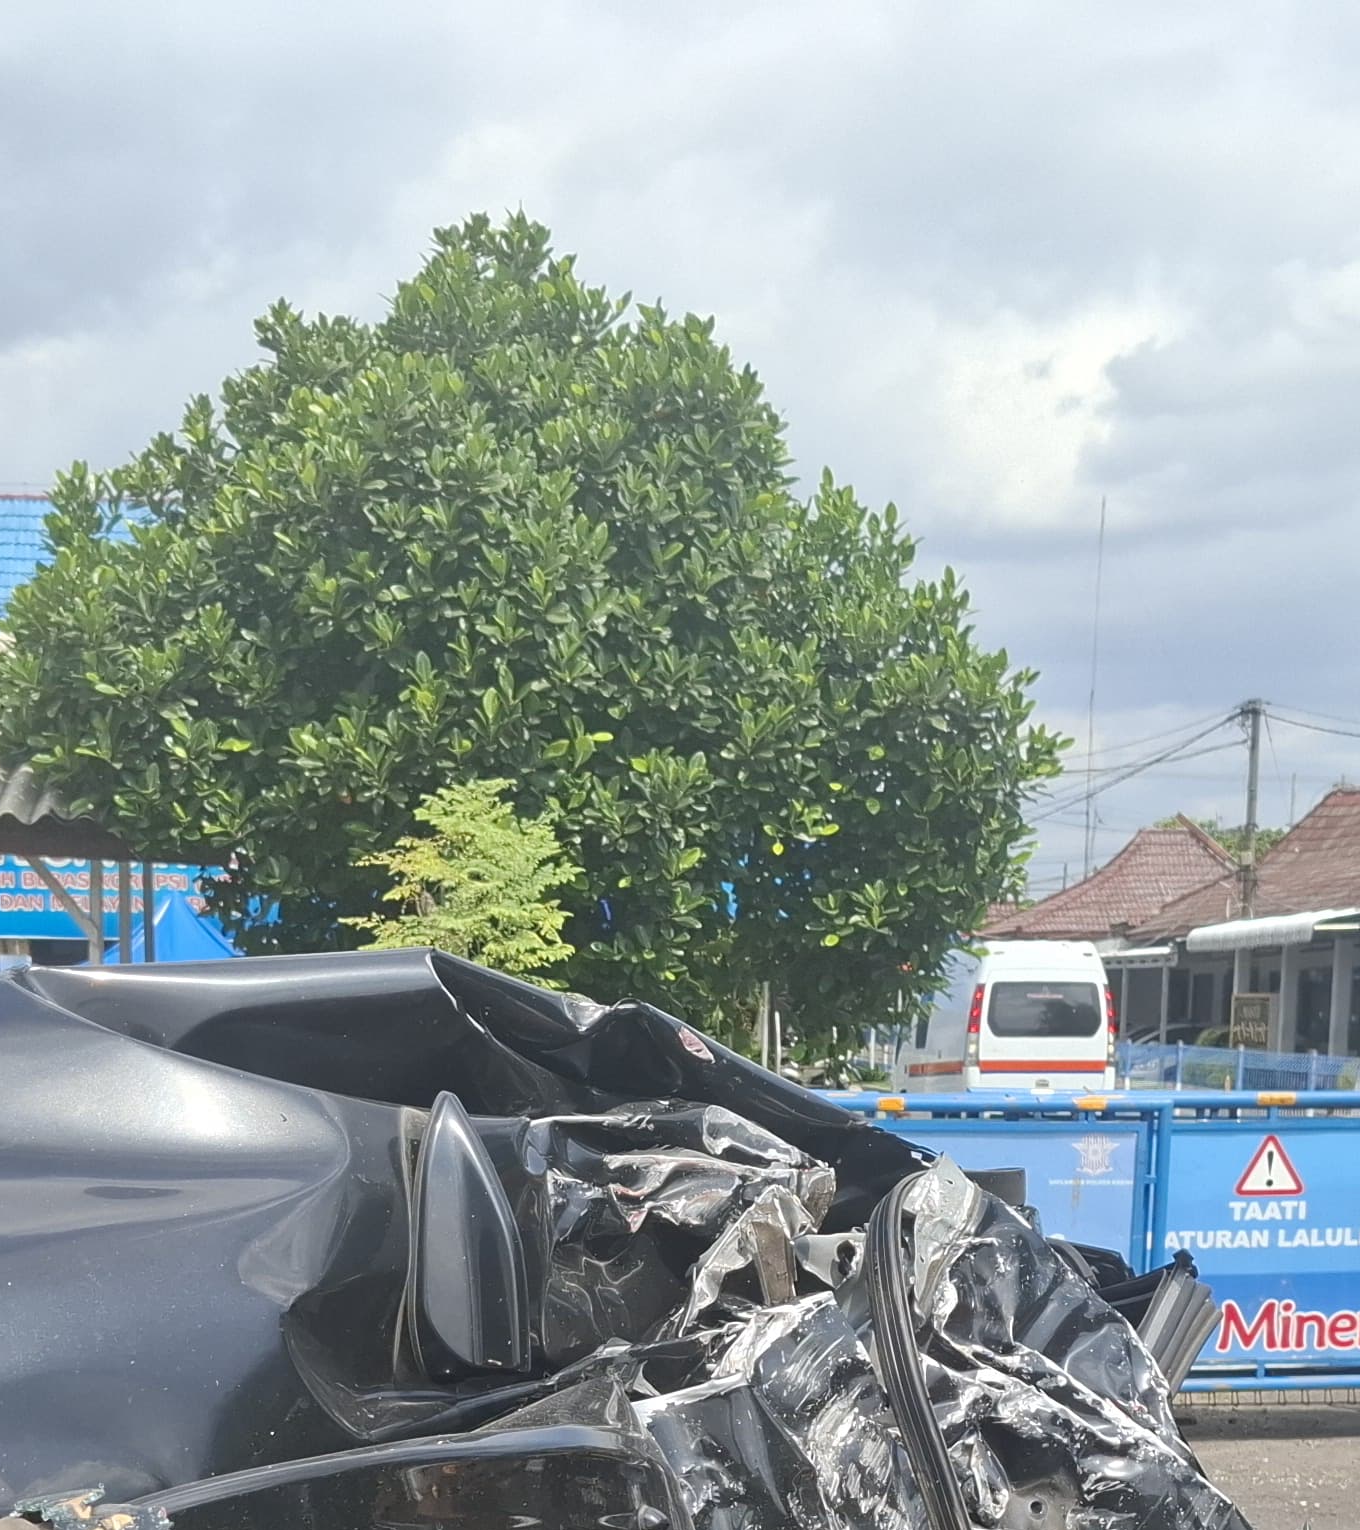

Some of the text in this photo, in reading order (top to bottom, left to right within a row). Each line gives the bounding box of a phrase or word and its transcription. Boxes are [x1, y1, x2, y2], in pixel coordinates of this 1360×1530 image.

[21, 871, 90, 890] BEAS
[99, 872, 189, 892] KORPSI
[0, 892, 44, 912] DAN
[1229, 1201, 1307, 1221] TAATI
[1147, 1228, 1270, 1250] ATURAN
